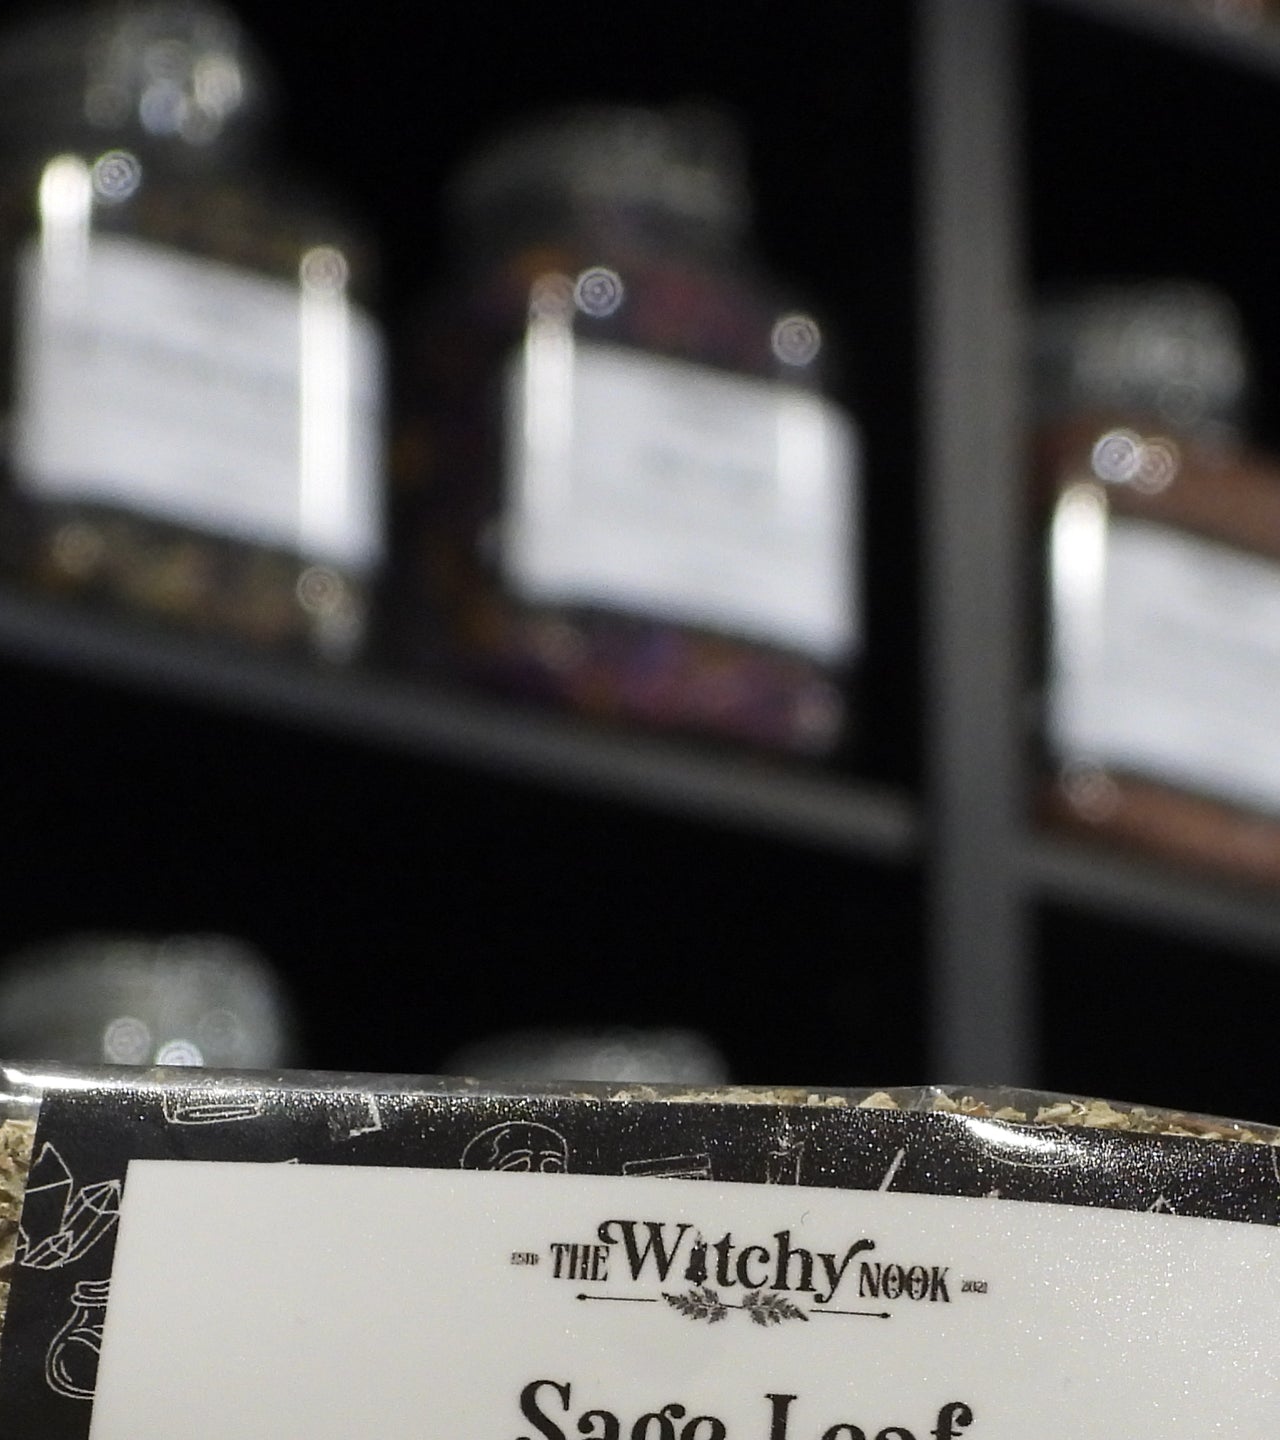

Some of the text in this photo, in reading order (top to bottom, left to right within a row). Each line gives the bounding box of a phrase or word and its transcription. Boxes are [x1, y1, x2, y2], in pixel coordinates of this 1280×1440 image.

[549, 1242, 609, 1282] THE
[596, 1219, 877, 1304] Witchy
[858, 1261, 951, 1303] NOOK
